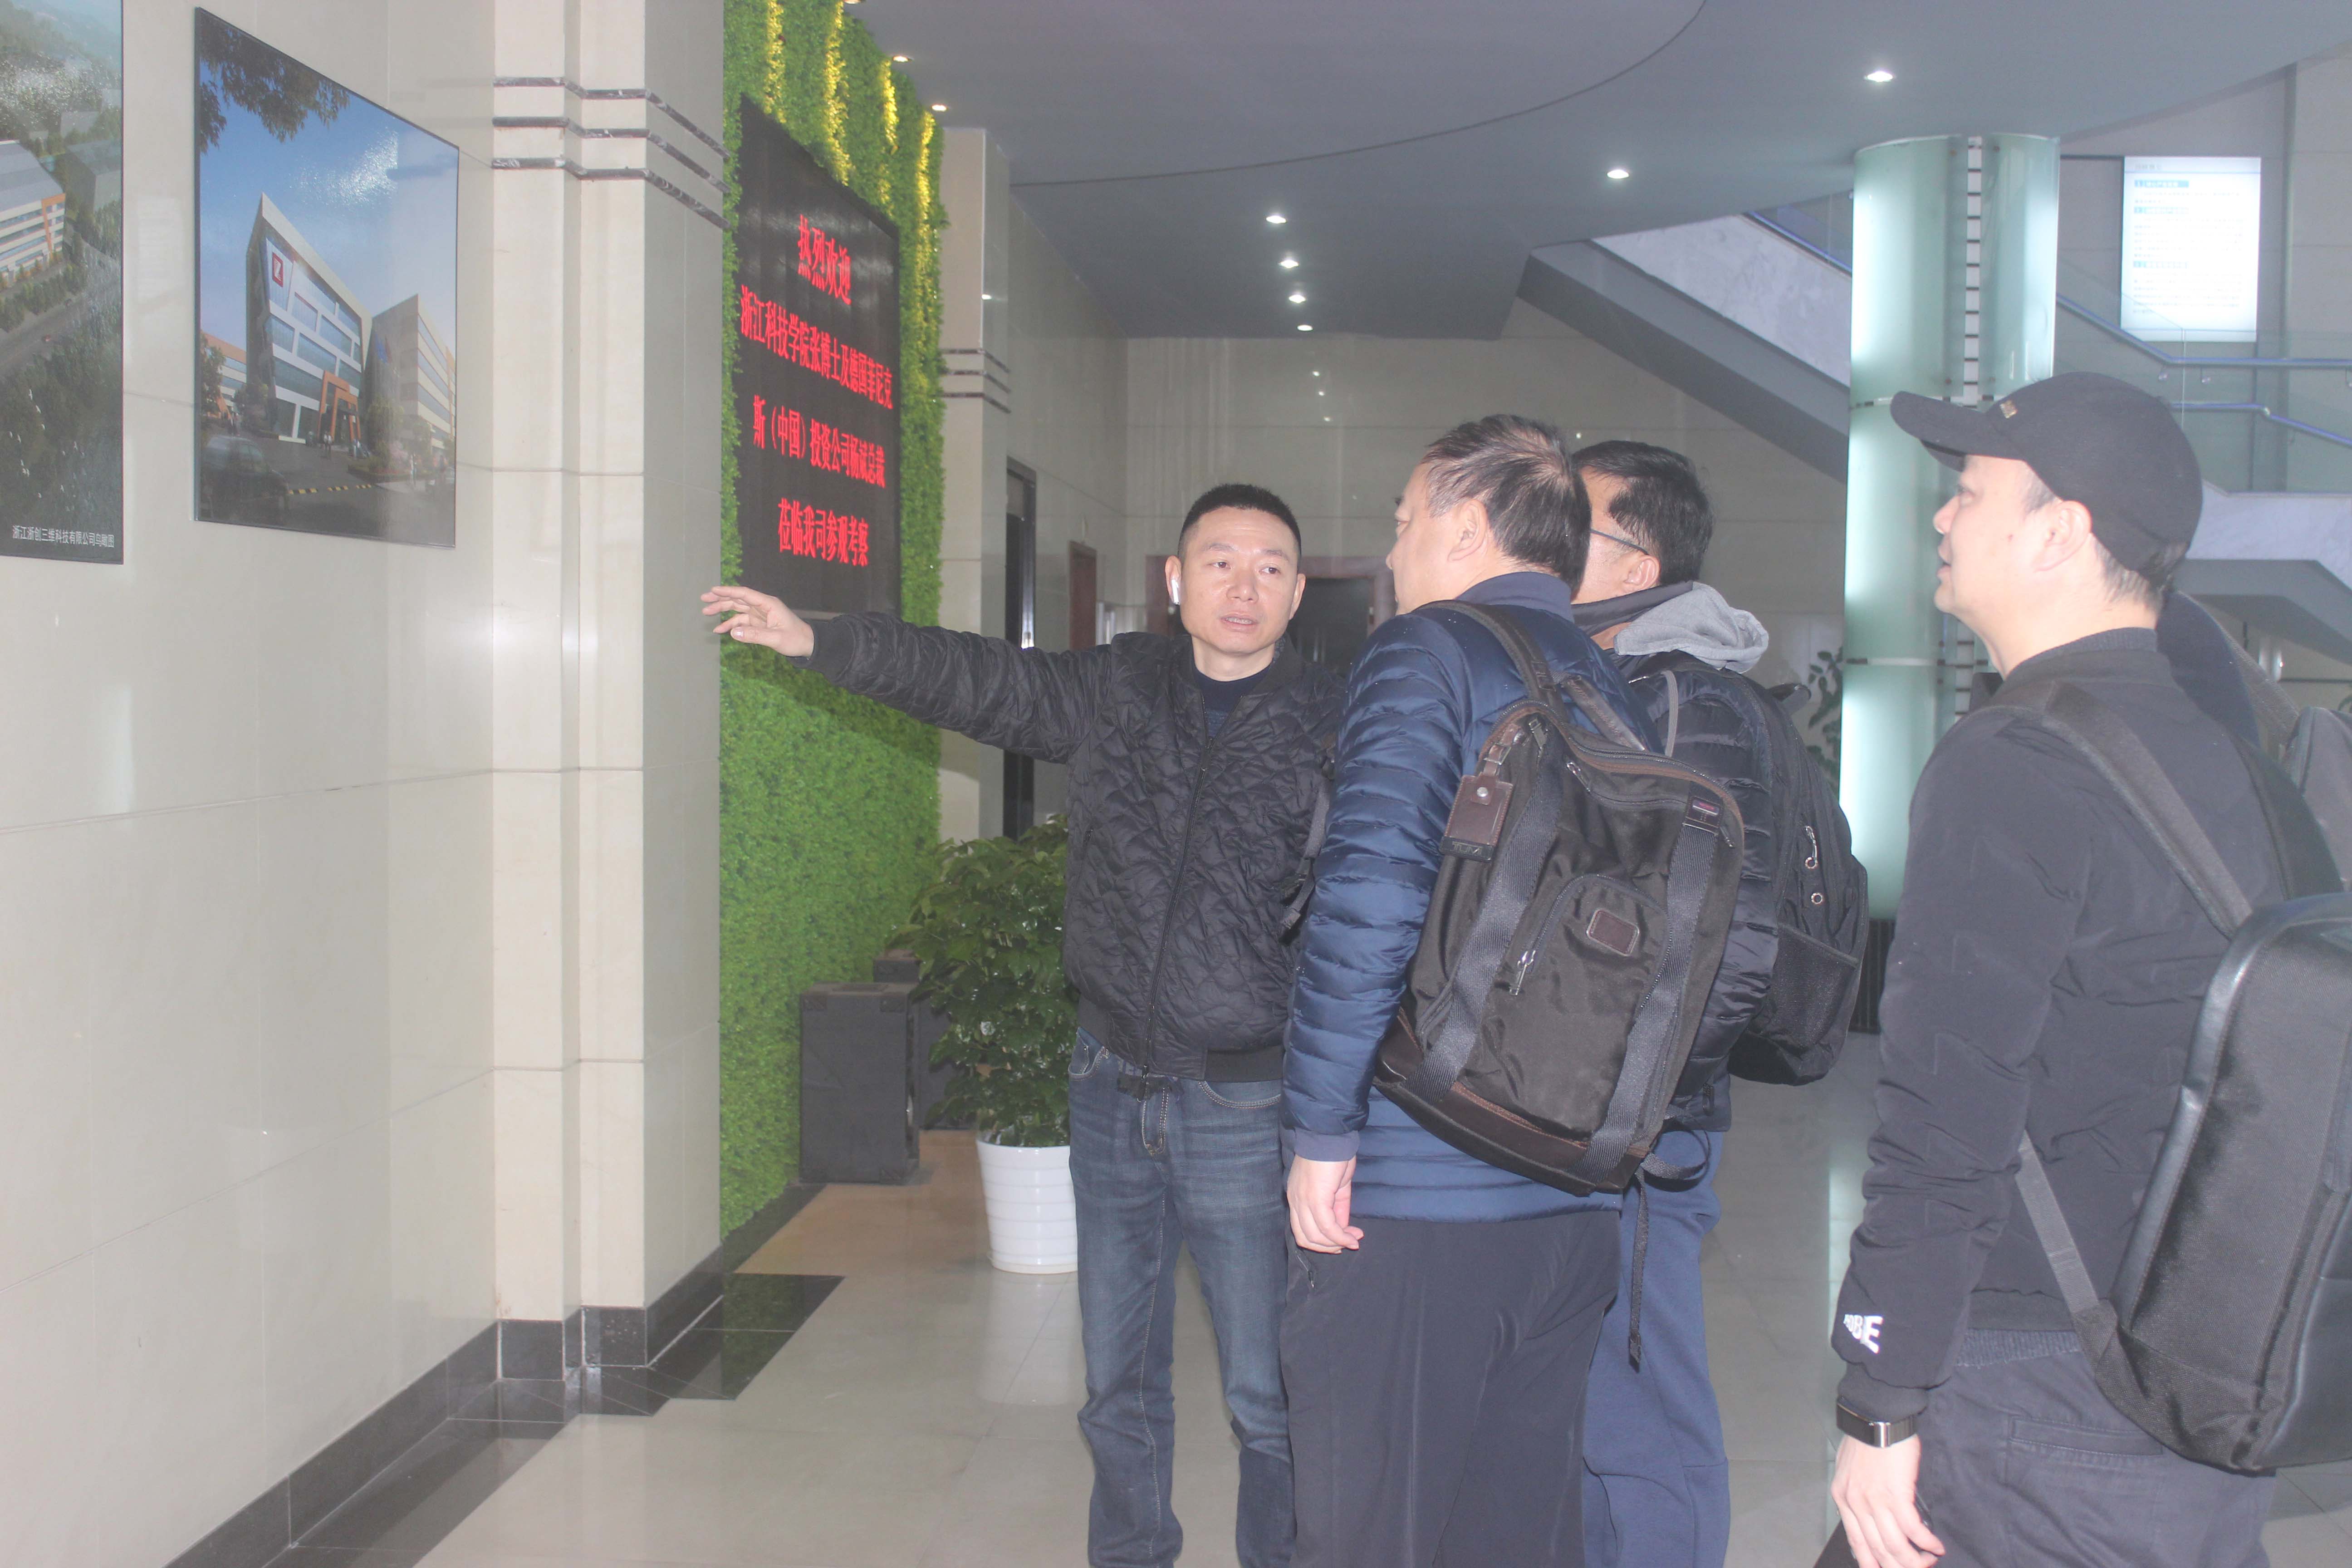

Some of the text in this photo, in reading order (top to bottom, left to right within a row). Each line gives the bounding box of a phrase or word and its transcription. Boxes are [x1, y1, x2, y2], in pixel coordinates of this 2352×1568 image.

[797, 214, 851, 305] 热烈欢迎
[12, 525, 115, 548] 浙江浙创三维科技有限公司鸟瞰图
[777, 497, 869, 567] 莅临我司参观考察
